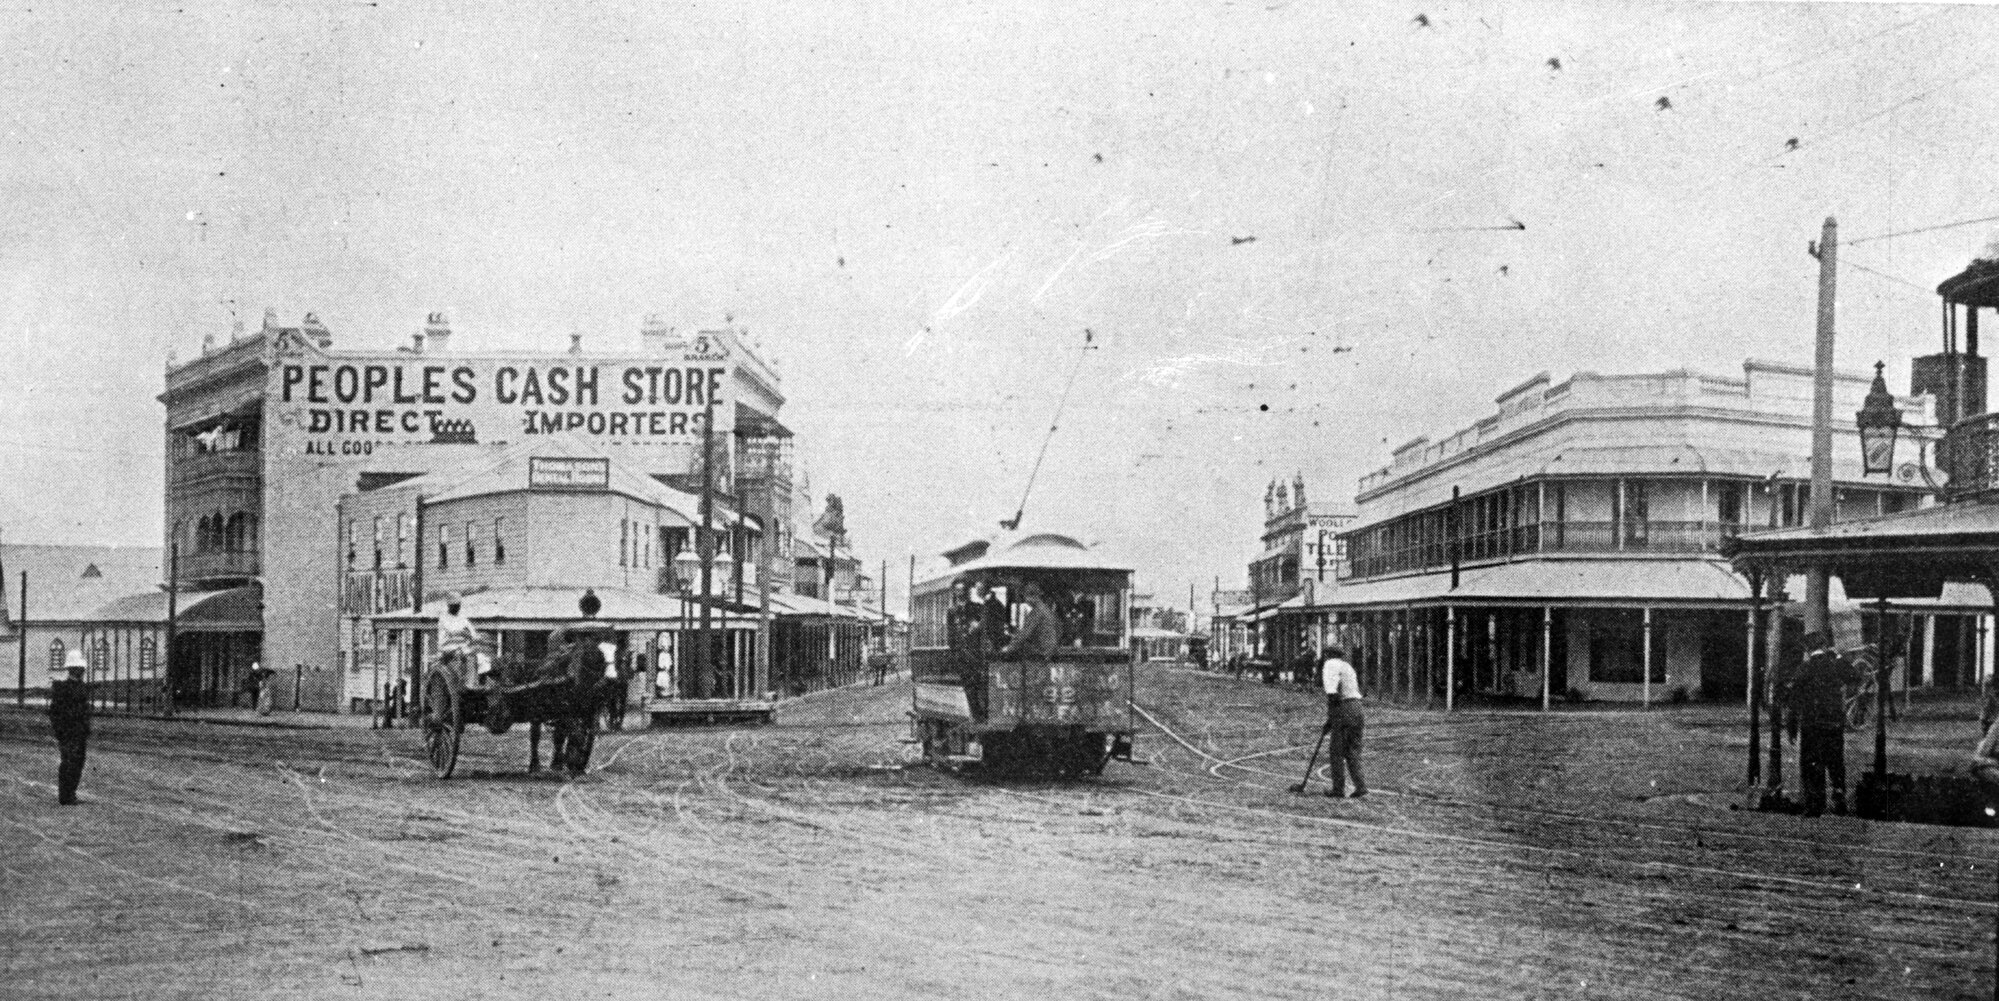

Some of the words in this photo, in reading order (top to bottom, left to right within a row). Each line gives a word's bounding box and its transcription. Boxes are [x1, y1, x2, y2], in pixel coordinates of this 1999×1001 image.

[282, 365, 476, 404] PEOPLES
[496, 367, 598, 405] CASH
[623, 367, 726, 405] STORE
[308, 408, 442, 434] DIRECT
[525, 410, 705, 436] IMPORTERS
[305, 441, 336, 456] ALL
